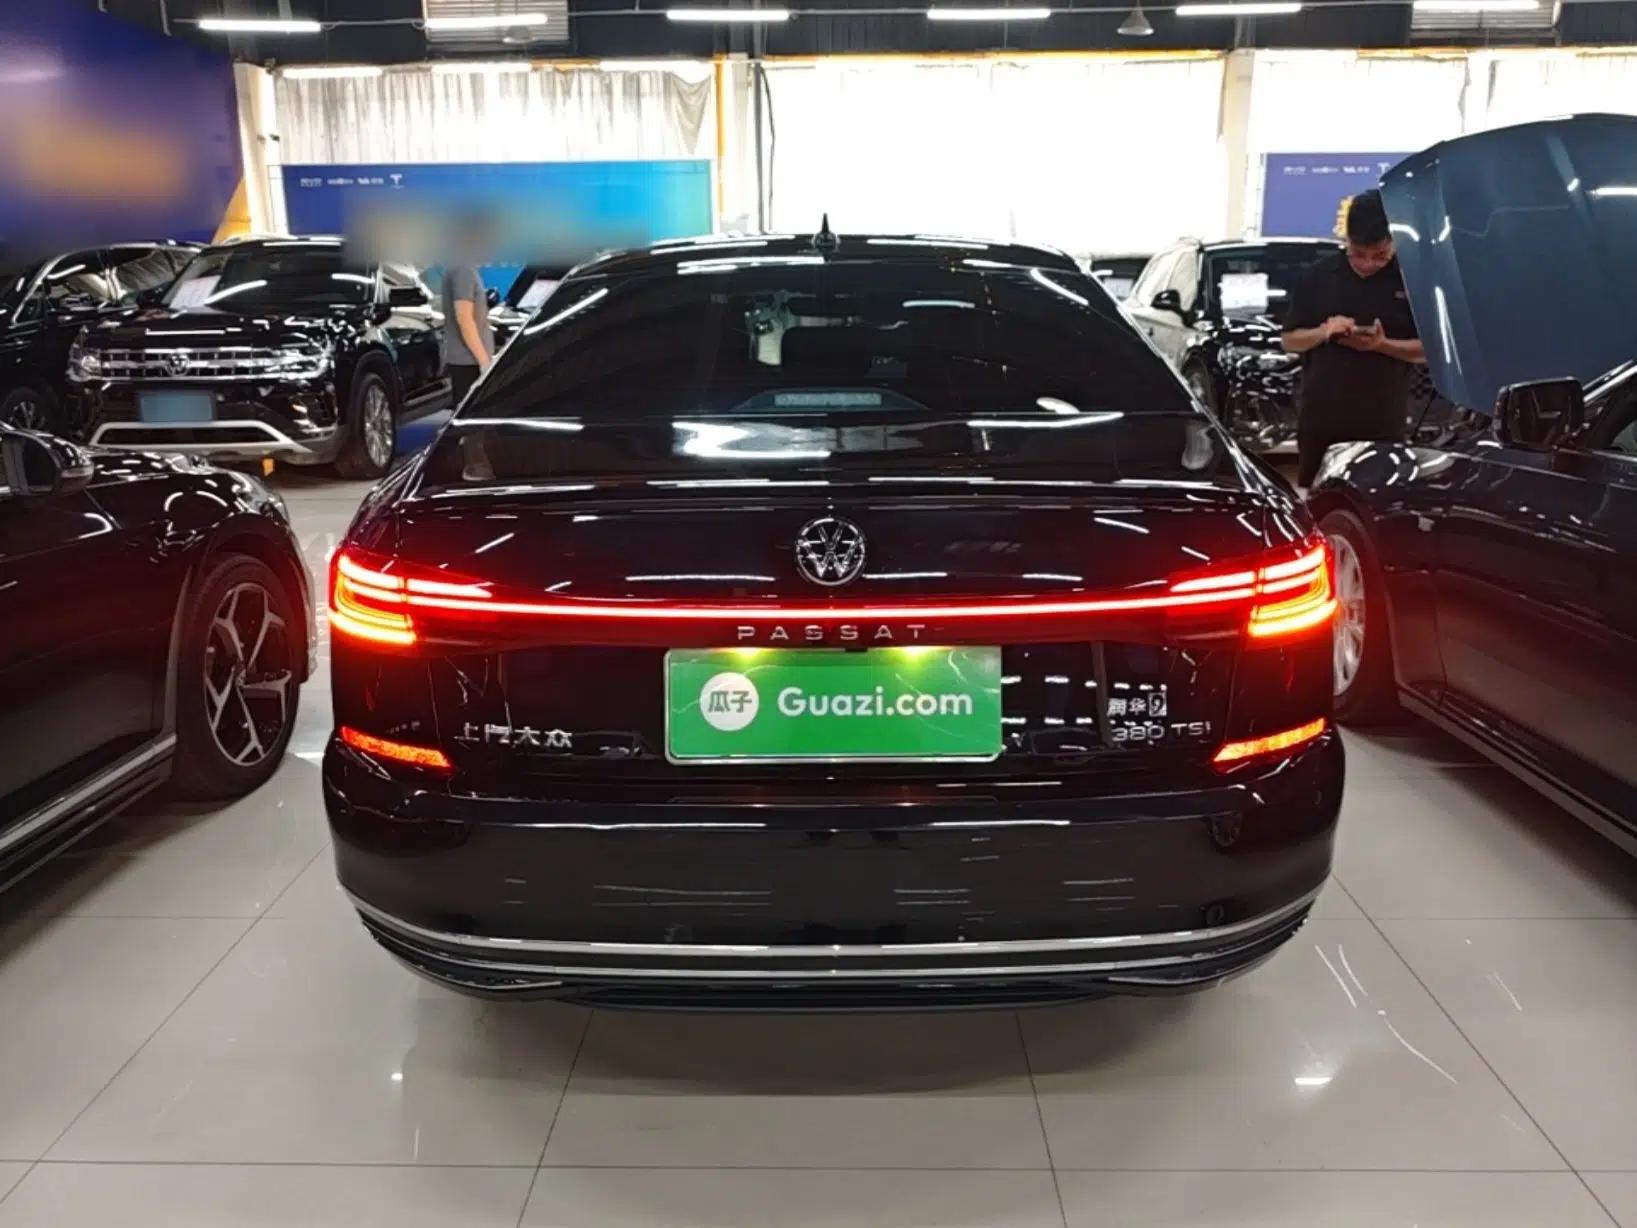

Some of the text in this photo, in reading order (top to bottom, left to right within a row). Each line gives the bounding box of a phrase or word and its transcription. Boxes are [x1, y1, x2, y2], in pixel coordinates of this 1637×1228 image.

[737, 624, 926, 641] PASSAT
[707, 689, 753, 714] 瓜子
[777, 685, 973, 717] Guazi.com
[1111, 725, 1165, 742] 380
